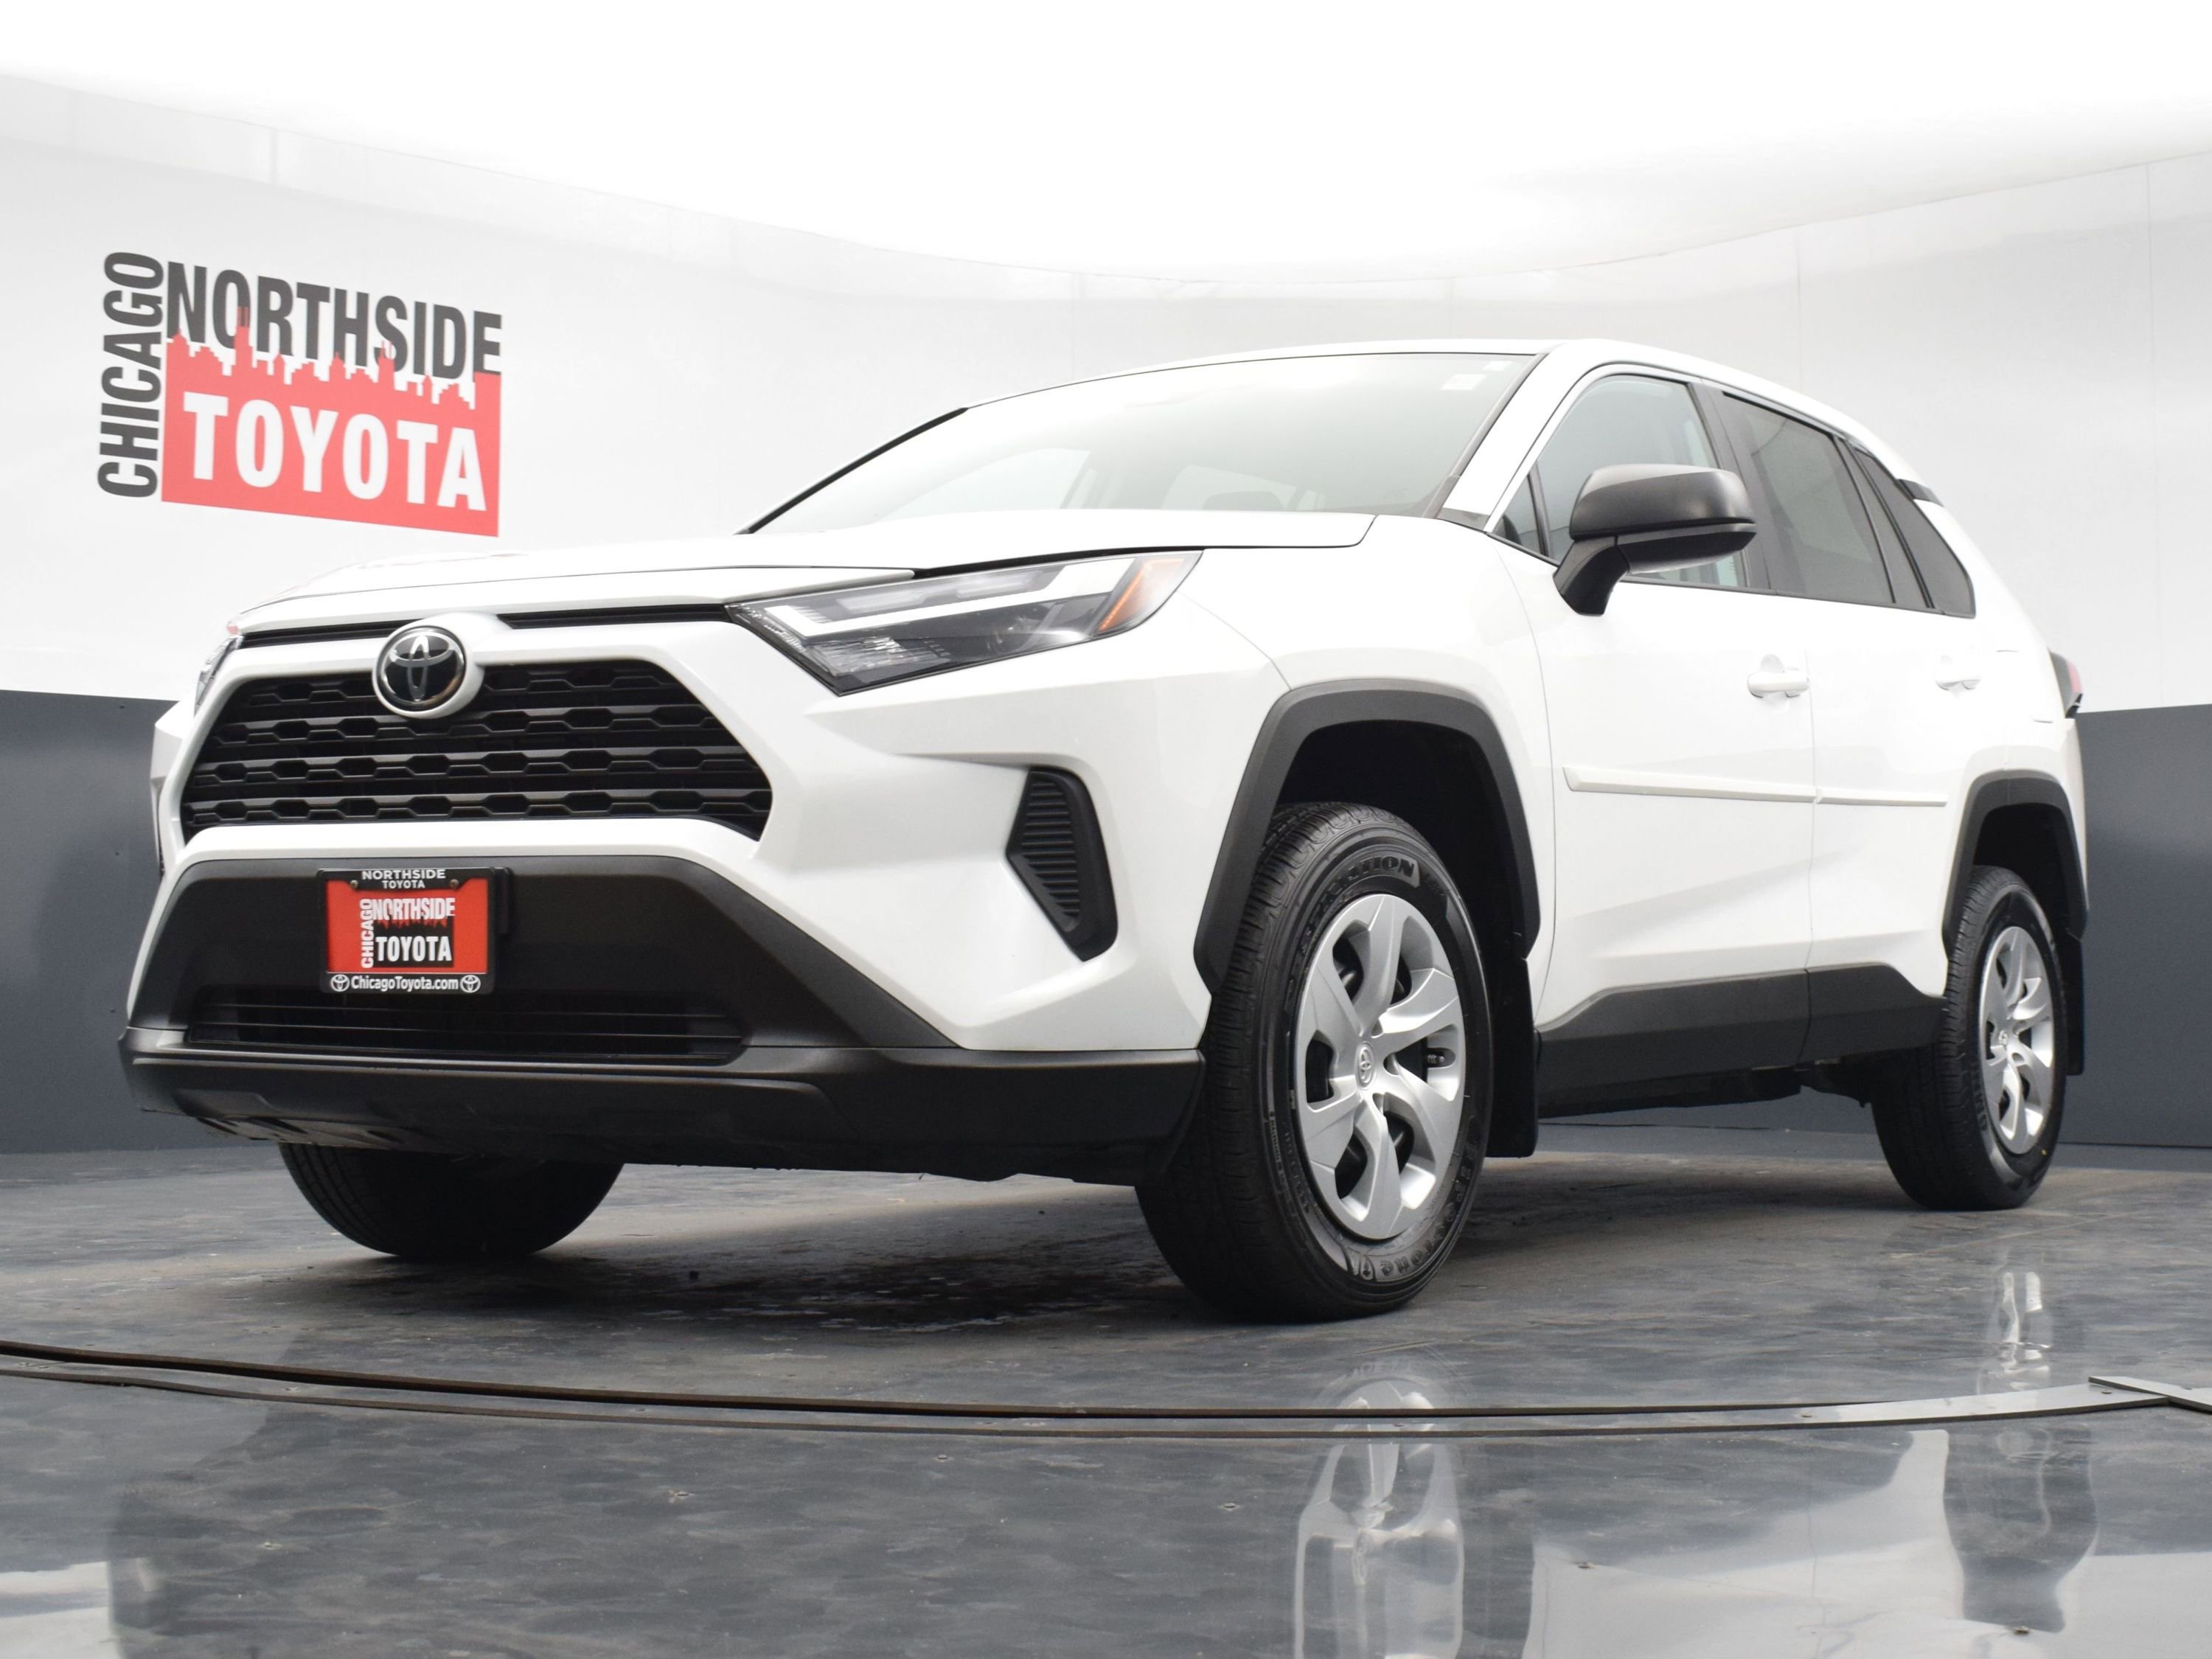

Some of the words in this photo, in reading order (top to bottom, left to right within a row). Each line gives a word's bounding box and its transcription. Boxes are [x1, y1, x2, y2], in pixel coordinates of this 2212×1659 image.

[167, 260, 502, 380] NORTHSIDE
[97, 251, 164, 498] CHICAGO
[183, 392, 487, 511] TOYOTA
[362, 869, 447, 880] NORTHSIDE
[382, 880, 425, 889] TOYOTA
[372, 897, 456, 920] NORTHSIDE
[360, 898, 375, 969] CHICAGO
[375, 936, 453, 962] TOYOTA
[351, 975, 459, 992] ChicagoToyota.com
